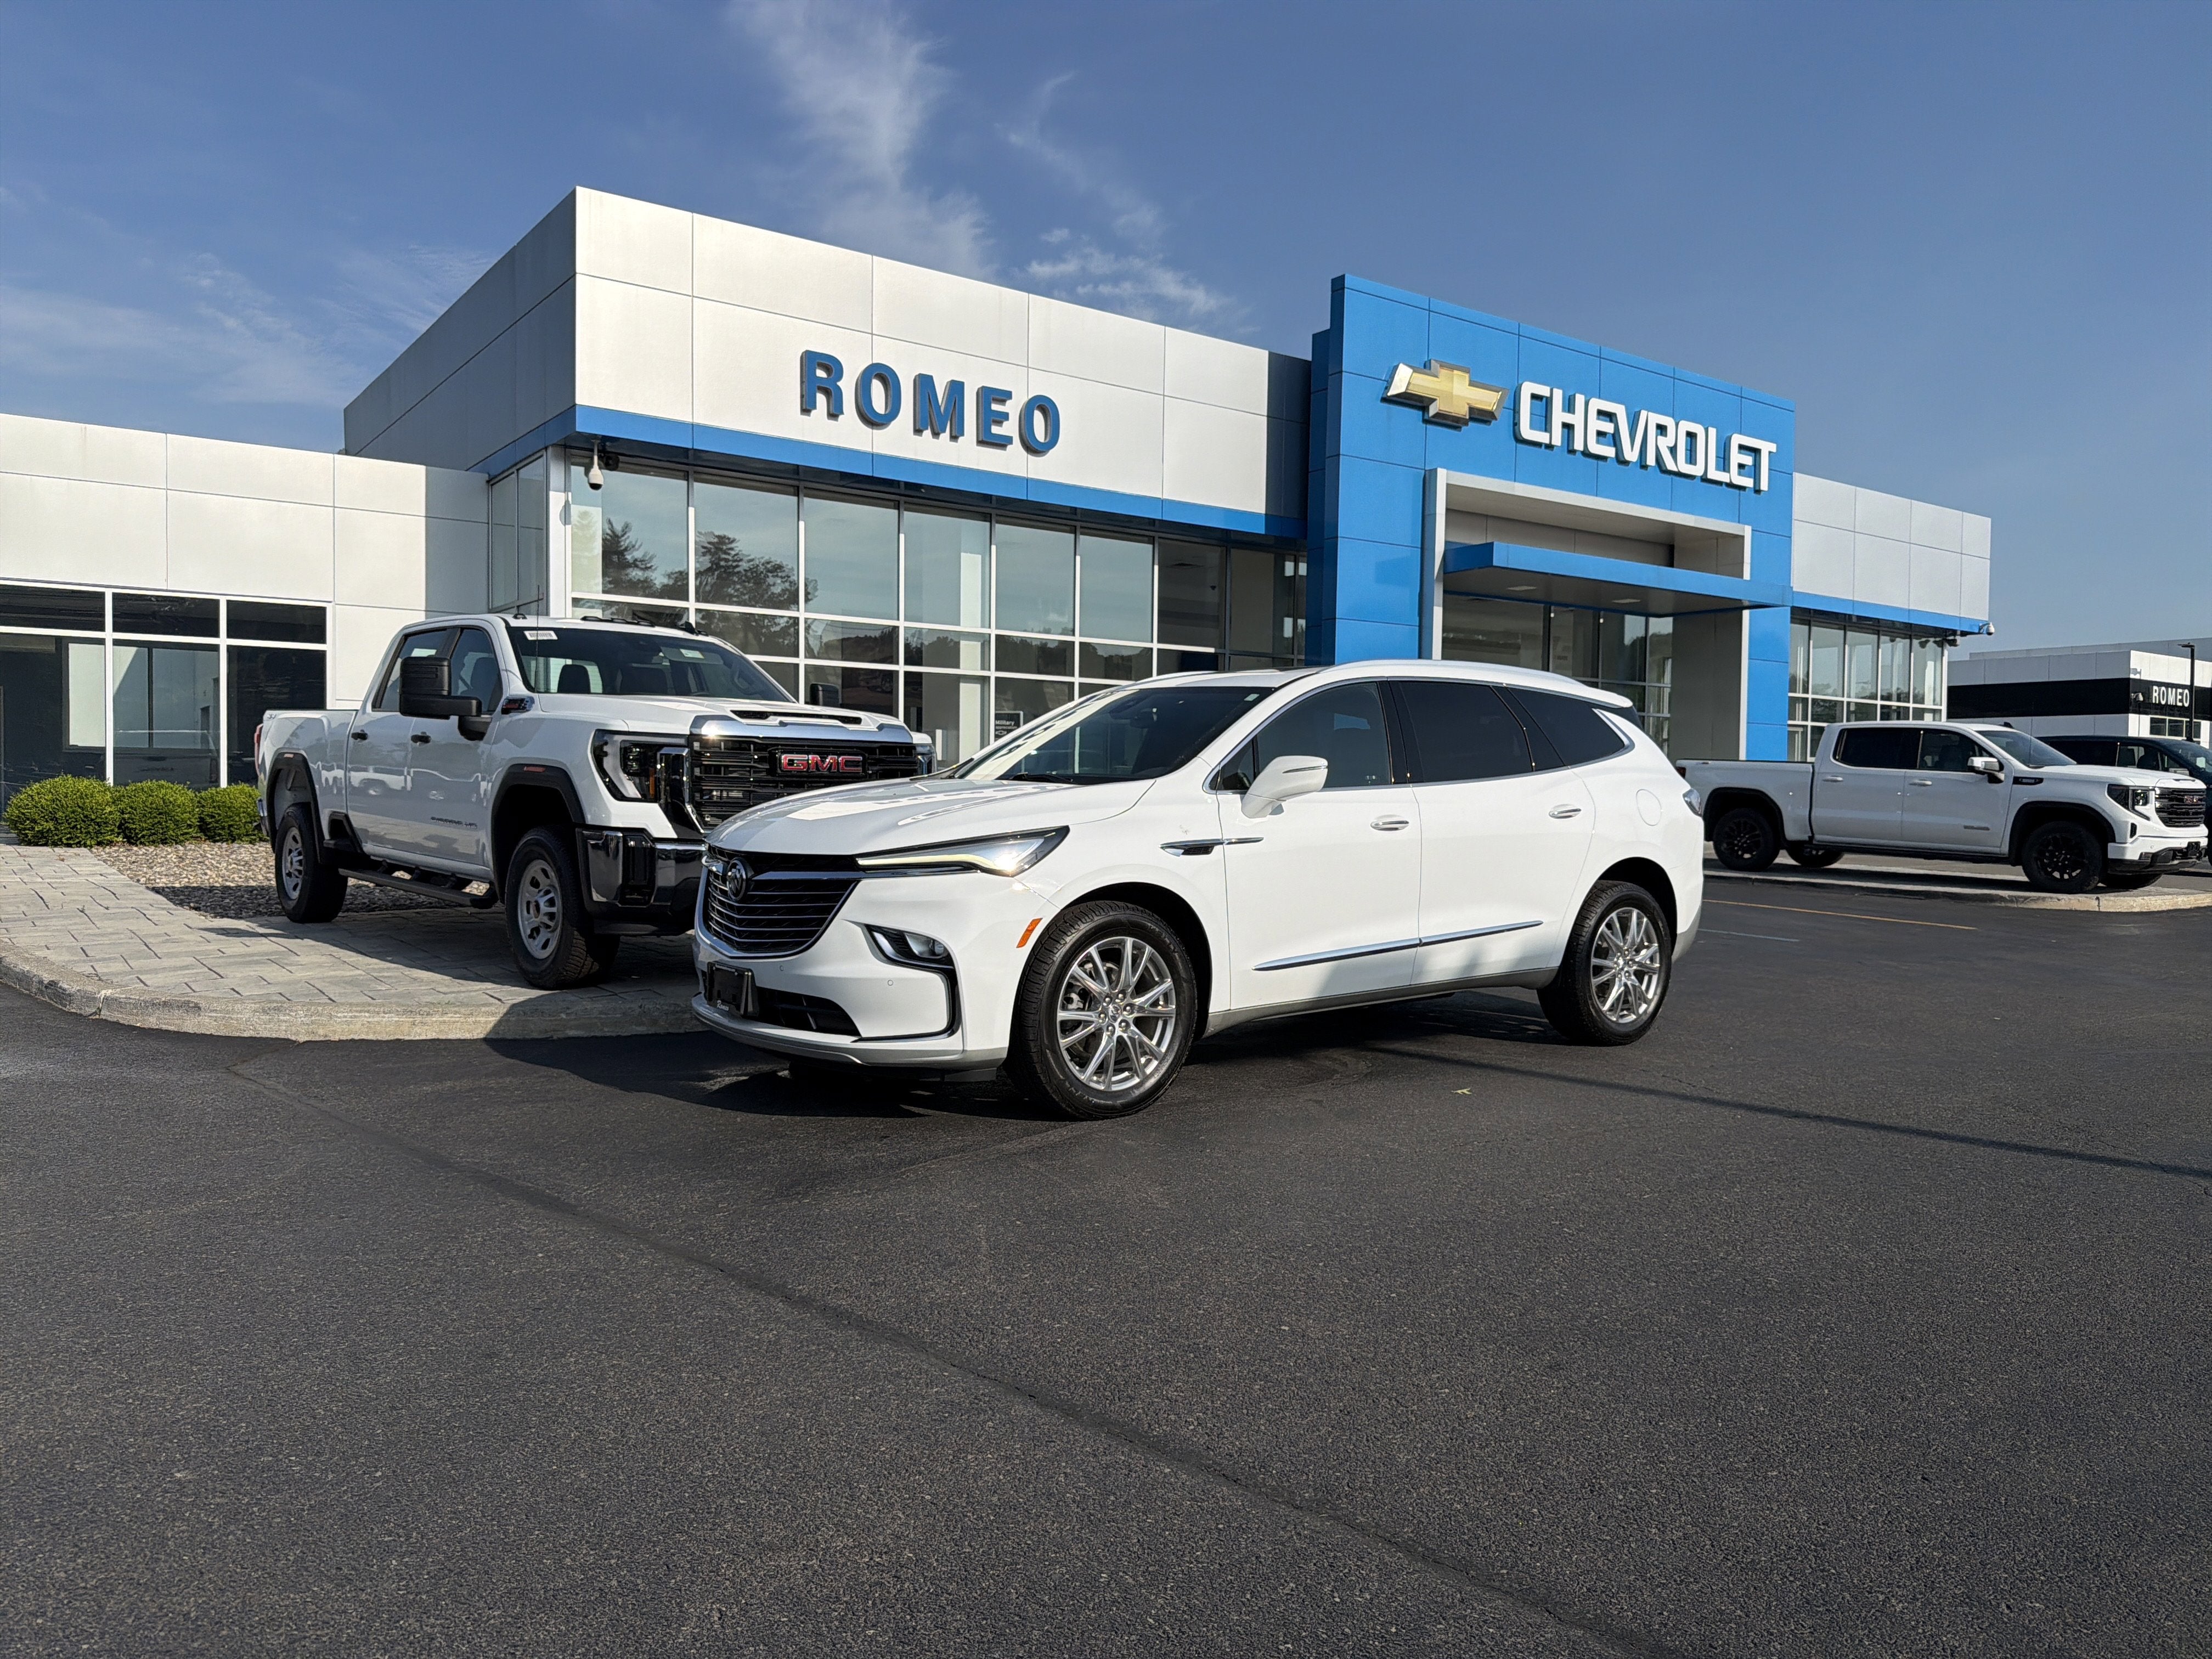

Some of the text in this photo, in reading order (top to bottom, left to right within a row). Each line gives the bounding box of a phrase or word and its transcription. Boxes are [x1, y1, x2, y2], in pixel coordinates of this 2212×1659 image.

[800, 349, 1060, 455] ROMEO
[1515, 381, 1777, 492] CHEVROLET
[2152, 685, 2190, 707] ROMEO
[781, 754, 863, 772] GMC
